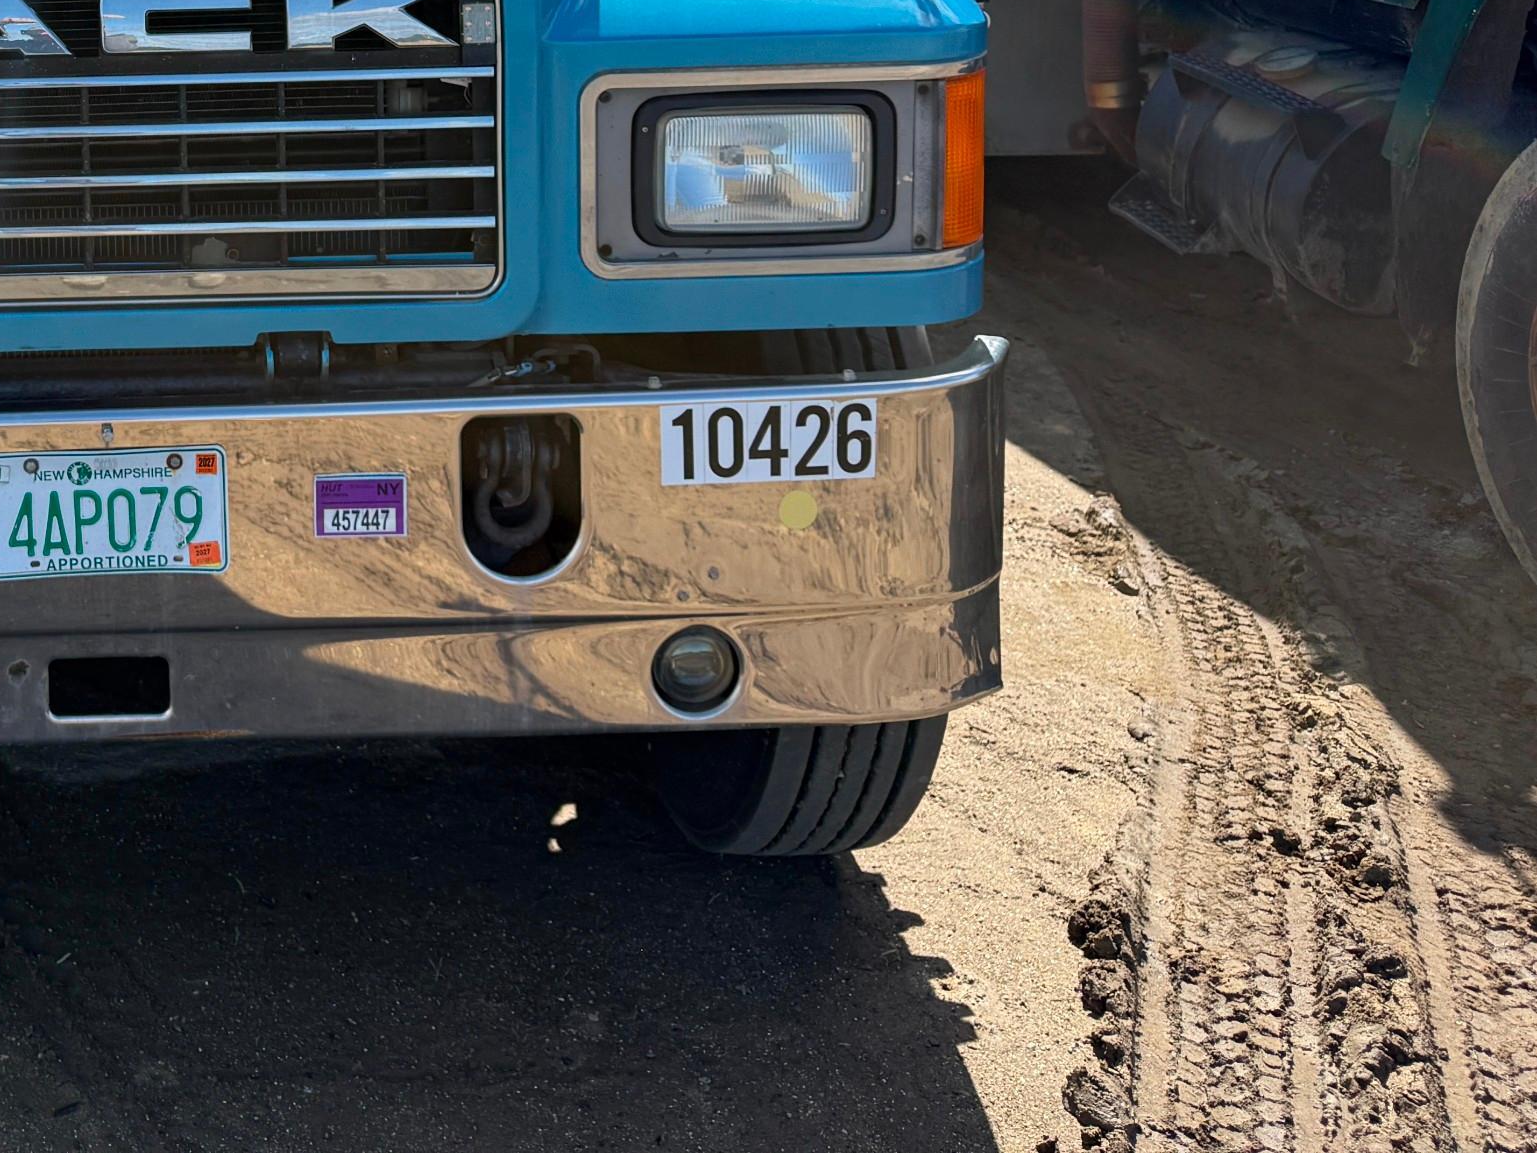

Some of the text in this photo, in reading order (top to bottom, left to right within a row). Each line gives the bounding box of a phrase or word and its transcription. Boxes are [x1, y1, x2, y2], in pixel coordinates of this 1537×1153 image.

[671, 402, 873, 481] 10426
[198, 457, 215, 467] 2027
[34, 470, 65, 482] NEW
[93, 467, 173, 480] HAMPSHIRE
[320, 483, 343, 493] HUT
[377, 482, 400, 496] NY
[8, 485, 203, 557] 4AP079
[331, 509, 390, 531] 457447
[46, 554, 169, 571] APPORTIONED
